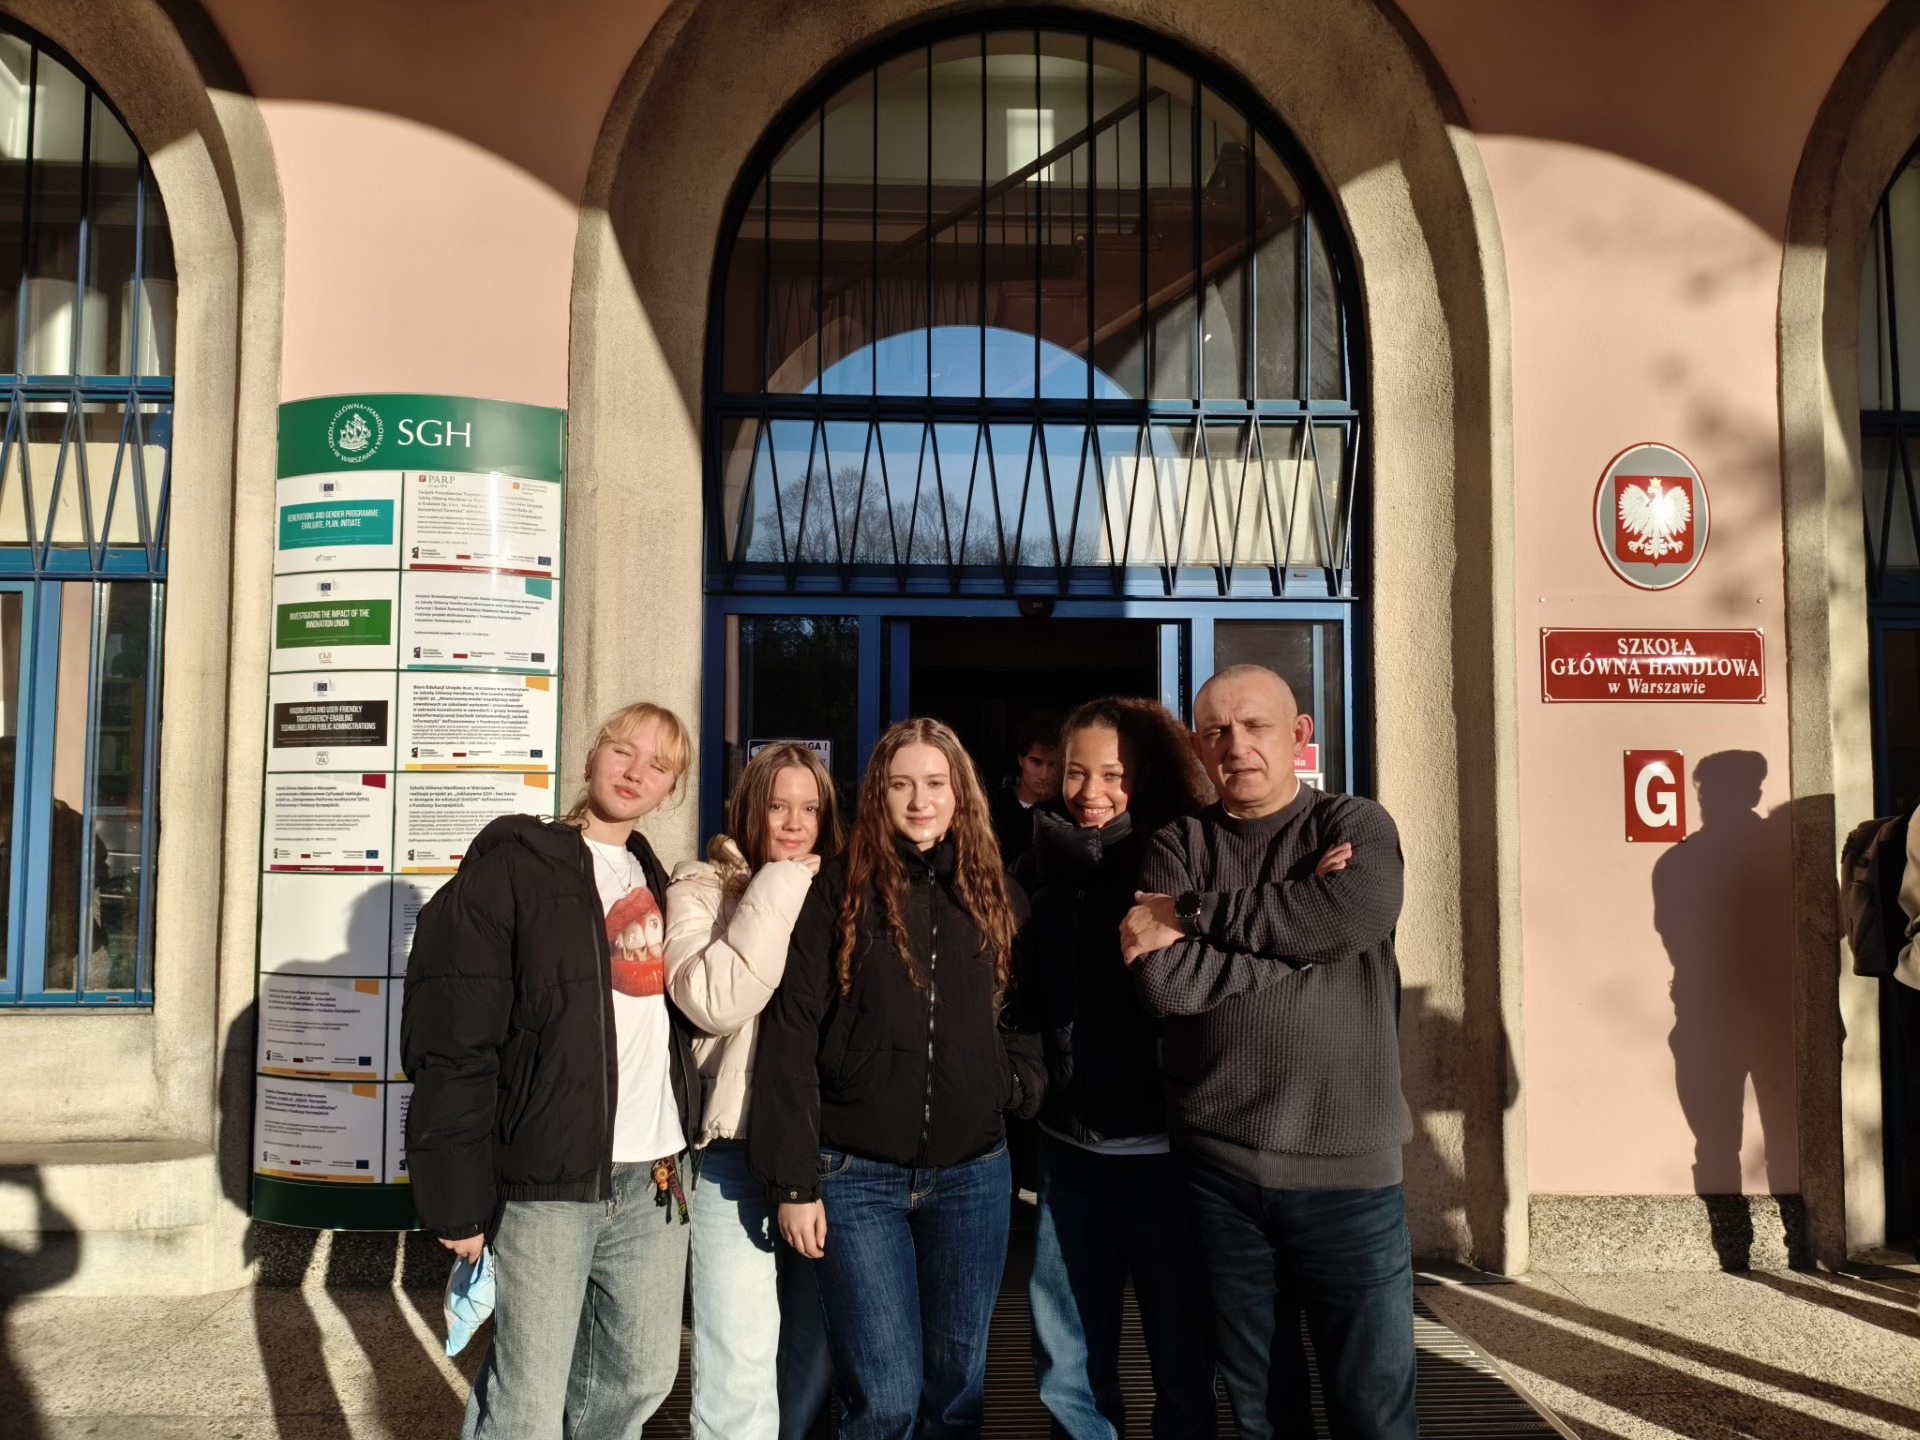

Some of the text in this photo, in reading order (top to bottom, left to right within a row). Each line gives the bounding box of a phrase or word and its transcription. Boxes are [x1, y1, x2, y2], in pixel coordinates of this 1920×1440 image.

[335, 402, 364, 418] GŁÓWNA
[366, 406, 385, 446] HANDLOWA
[398, 418, 471, 448] SGH
[328, 421, 336, 449] SZKOŁA
[341, 449, 377, 464] WARSZAWIE
[428, 475, 456, 484] PARP
[288, 509, 380, 522] GENERATIONS AND GENDER PROGRAMME:
[340, 518, 361, 527] INITIATE
[290, 610, 321, 620] INVESTIGATING
[322, 610, 331, 618] THE
[332, 610, 350, 618] IMPACT
[360, 609, 370, 617] THE
[306, 619, 350, 628] INNOVATION UNION
[1617, 638, 1696, 656] SZKOŁA
[1550, 652, 1759, 677] GŁÓWNA HANDLOWA
[1608, 678, 1706, 694] w Warszawie
[296, 714, 353, 723] TRANSPARENCY-ENABLING
[1634, 762, 1677, 826] G
